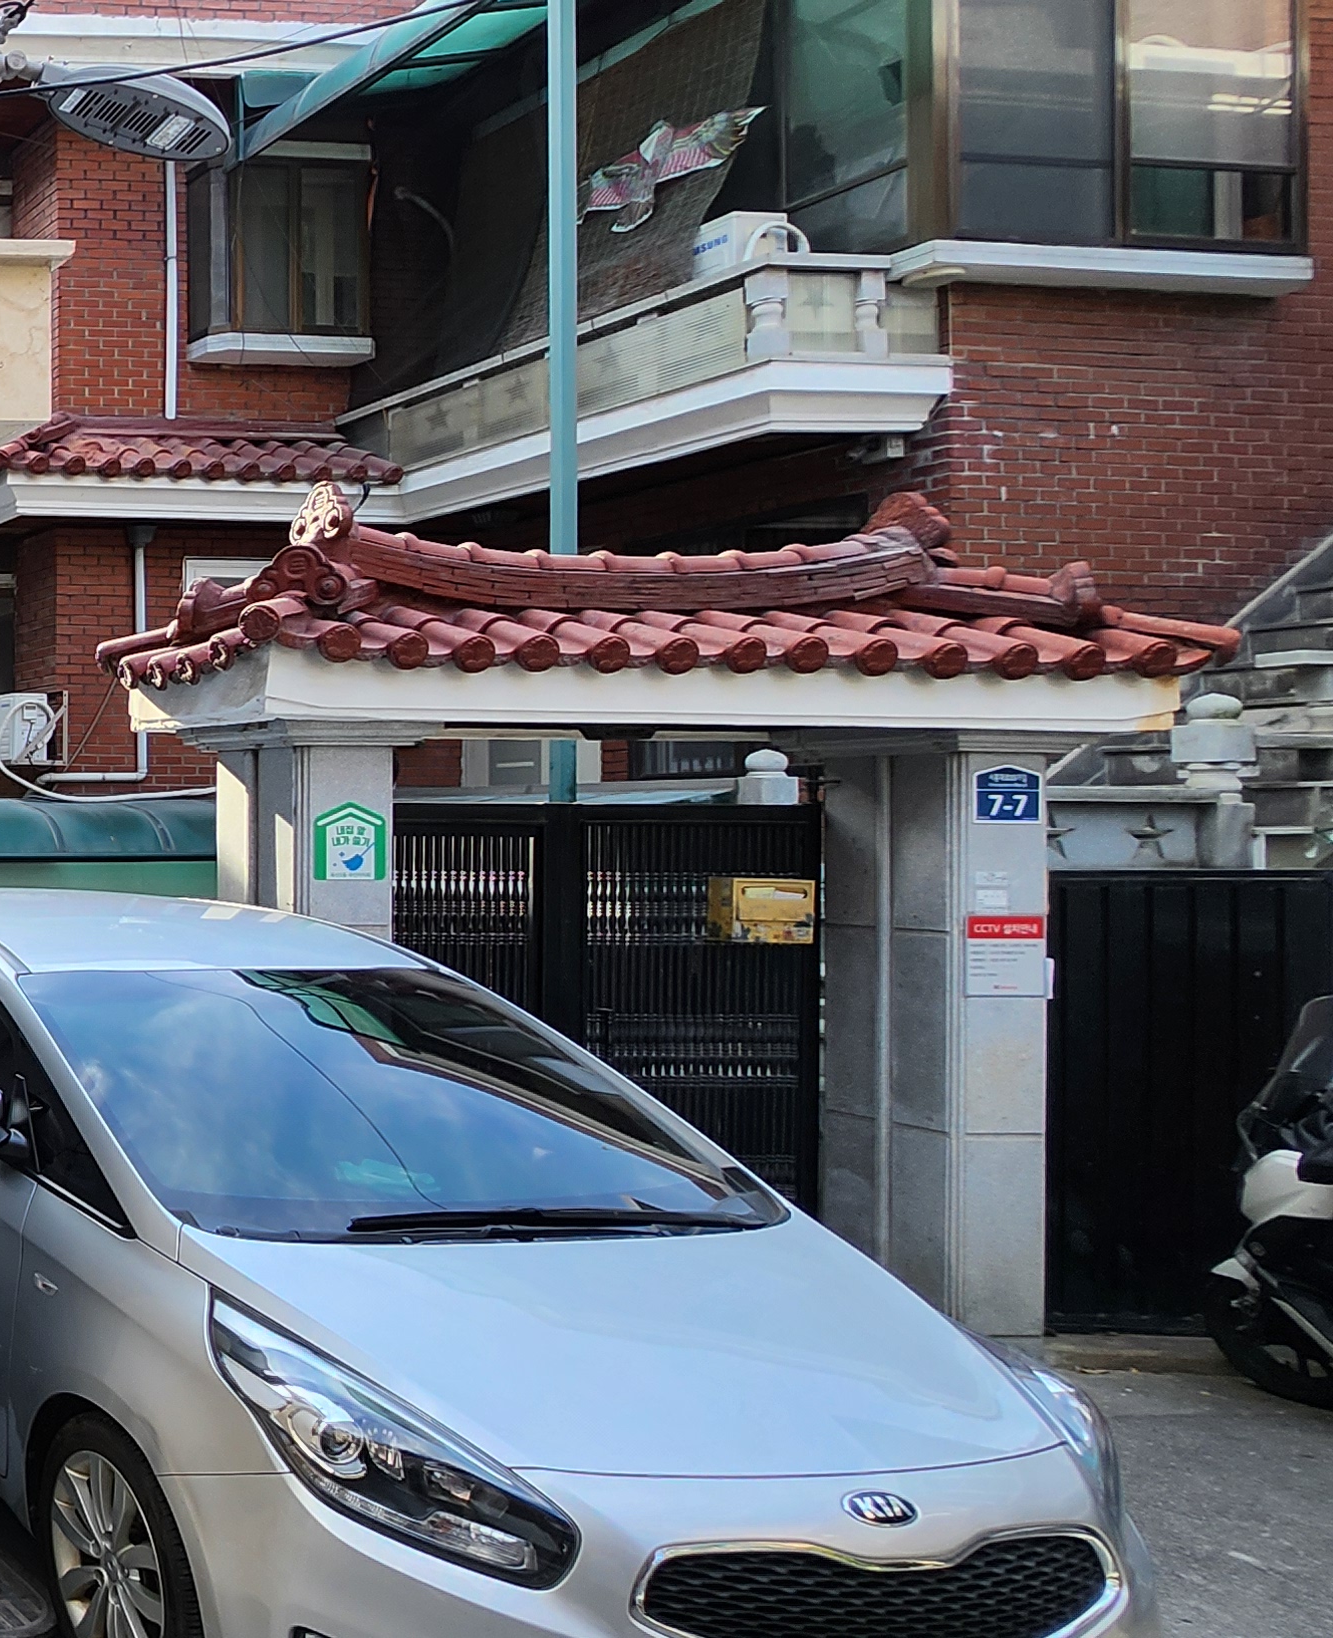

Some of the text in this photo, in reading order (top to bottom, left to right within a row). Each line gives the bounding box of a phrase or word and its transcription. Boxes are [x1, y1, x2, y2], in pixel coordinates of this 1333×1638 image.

[987, 794, 1029, 817] 7-7
[336, 825, 354, 836] 내집
[331, 836, 350, 847] 내가
[973, 923, 1001, 933] CCTV
[853, 1495, 914, 1519] KIA
